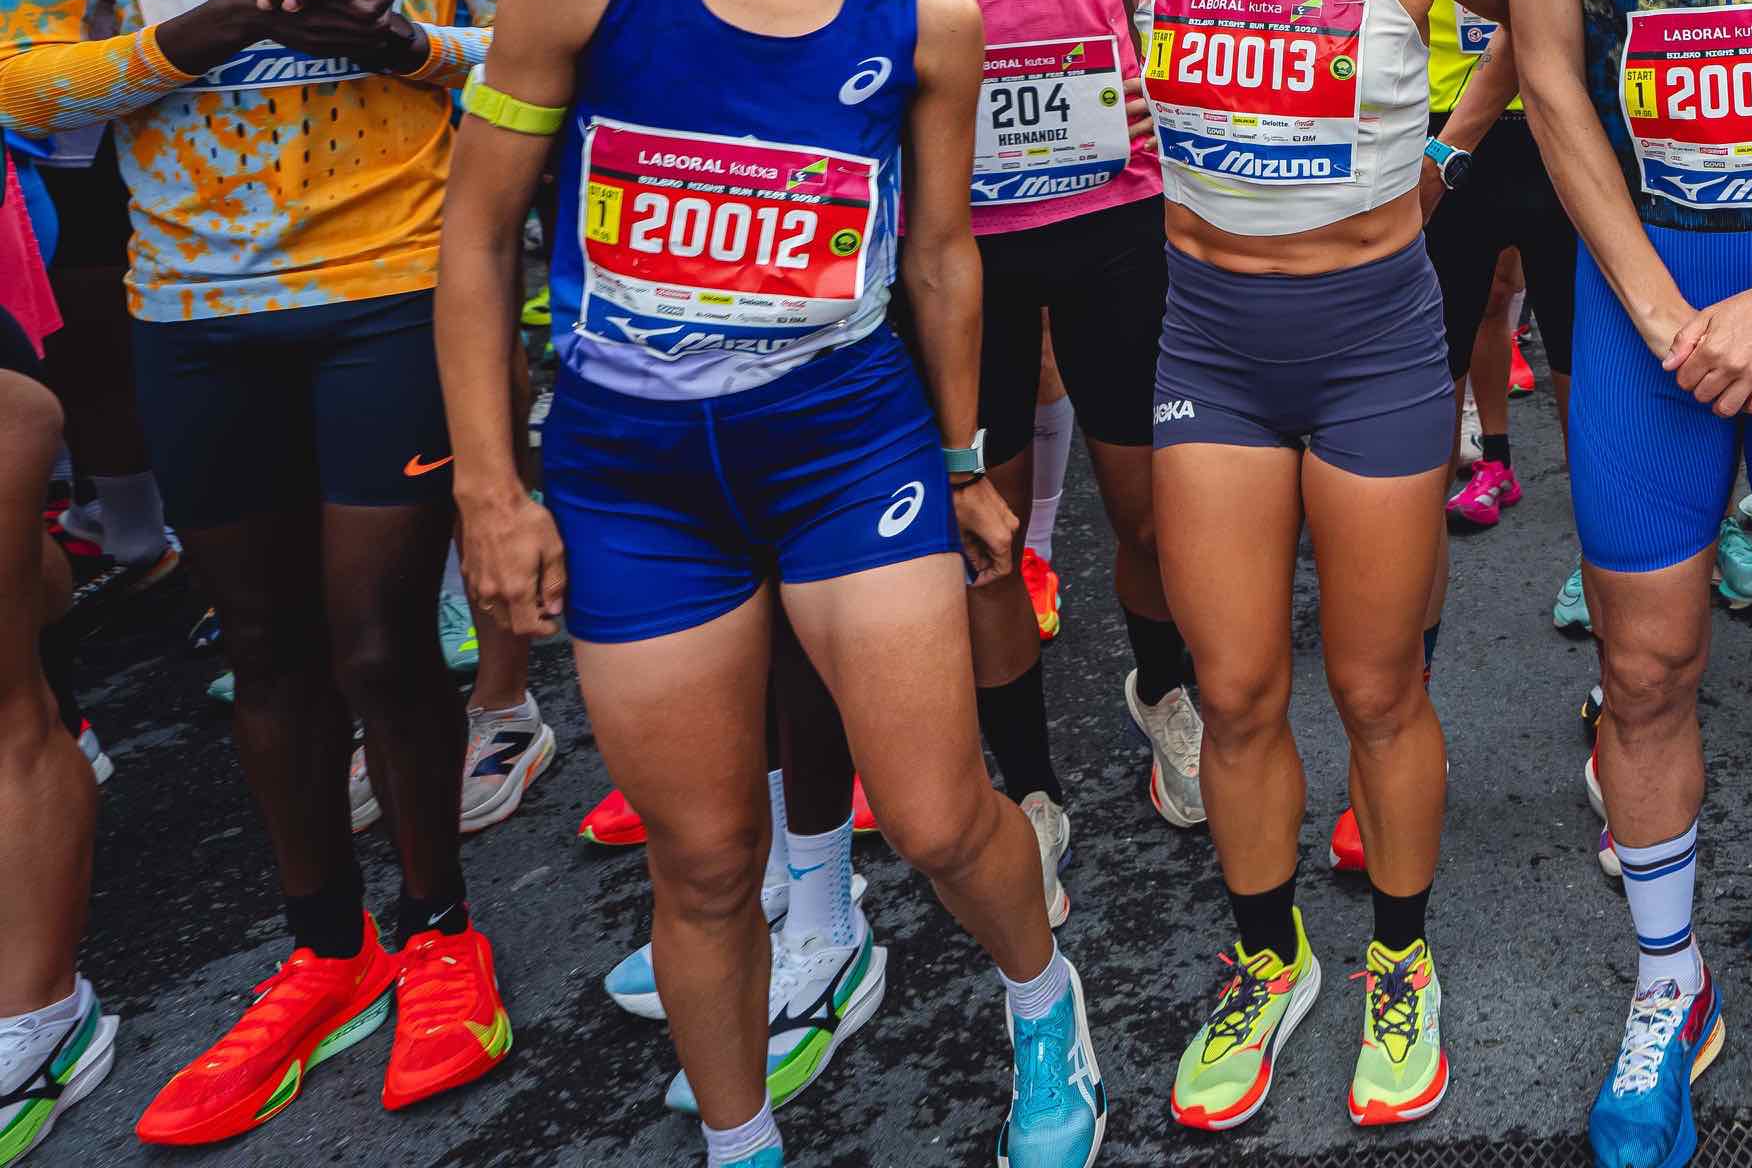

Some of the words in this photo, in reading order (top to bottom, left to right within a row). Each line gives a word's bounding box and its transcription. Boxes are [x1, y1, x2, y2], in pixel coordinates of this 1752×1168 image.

[1153, 31, 1173, 43] START
[1664, 28, 1731, 42] LABORAL
[983, 59, 1022, 70] BORAL
[1156, 42, 1163, 69] 1
[1178, 33, 1317, 92] 20013
[1666, 51, 1701, 60] BILBAO
[1705, 49, 1734, 58] NIGHT
[1627, 71, 1653, 81] START
[990, 83, 1070, 129] 204
[1635, 82, 1644, 109] 1
[1262, 120, 1289, 128] Deloitte
[998, 128, 1069, 146] HERNANDEZ
[639, 150, 725, 174] LABORAL
[729, 160, 779, 180] kutxa
[599, 201, 606, 227] 1
[629, 192, 818, 269] 20012
